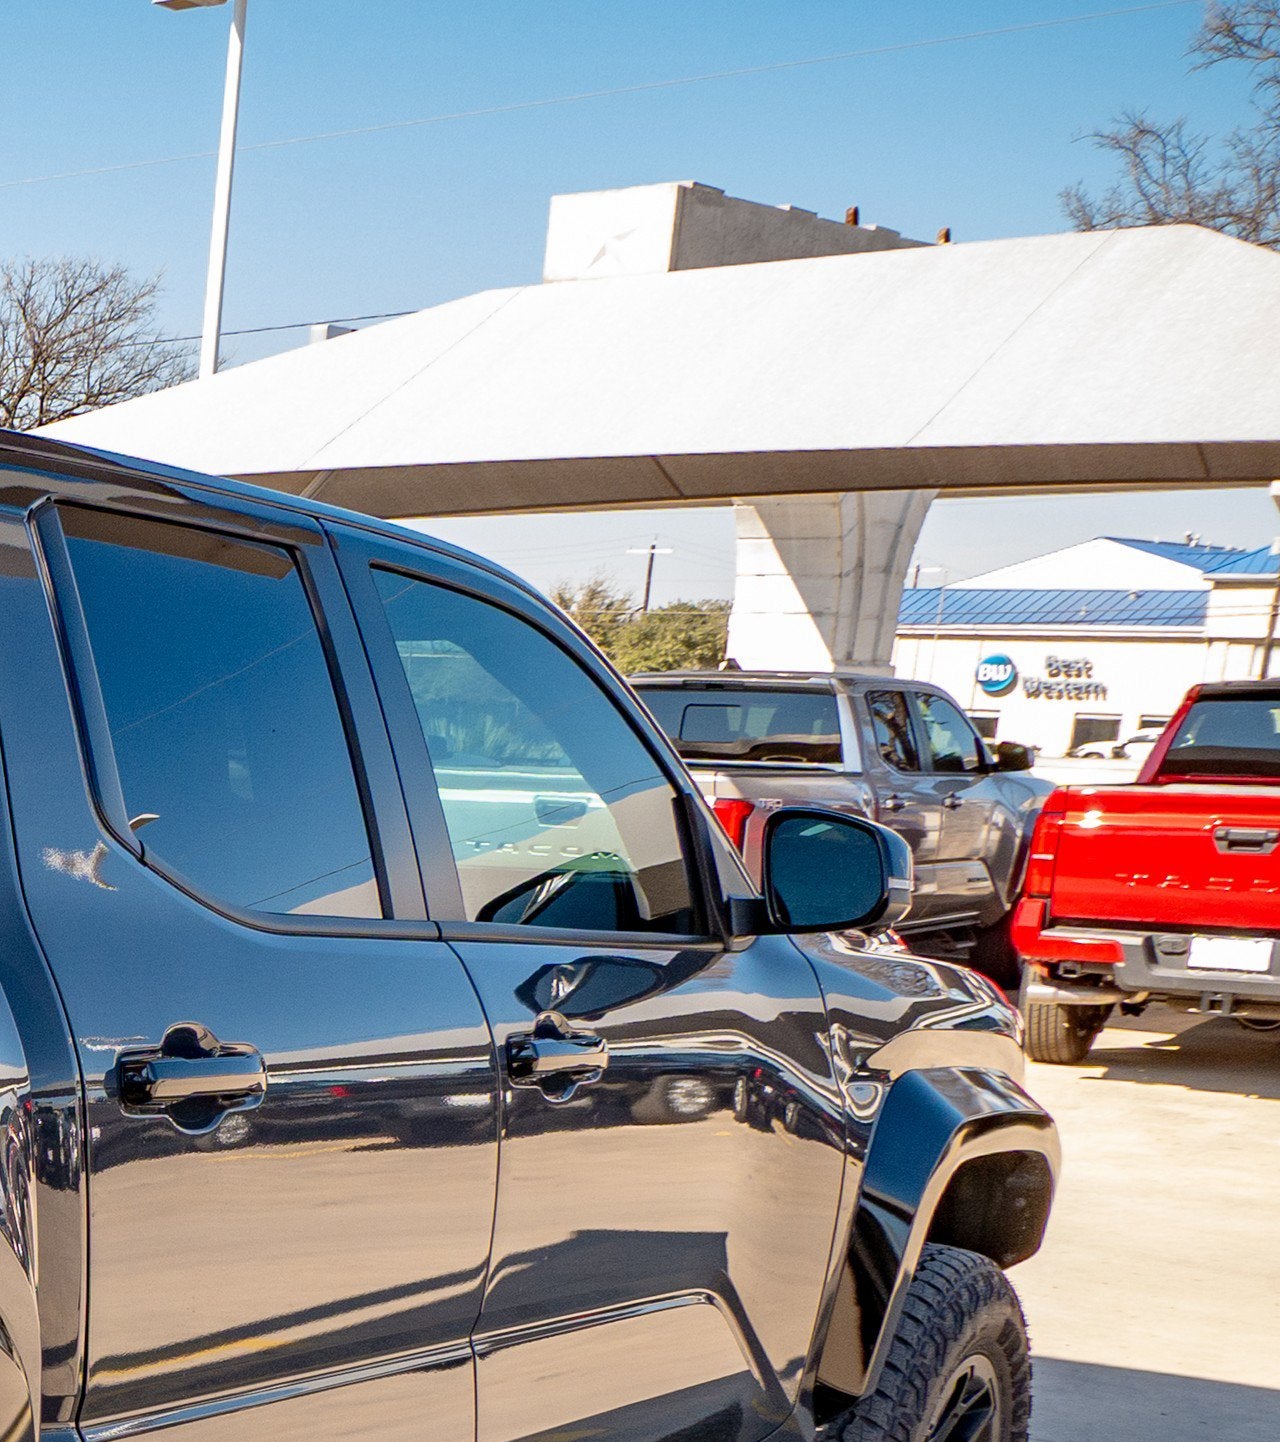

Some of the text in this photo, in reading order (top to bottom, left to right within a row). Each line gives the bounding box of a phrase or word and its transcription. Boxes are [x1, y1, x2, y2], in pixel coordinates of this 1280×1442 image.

[977, 664, 1012, 681] BW
[1045, 655, 1093, 678] Best
[1022, 677, 1108, 701] Western
[465, 840, 630, 861] TACOM
